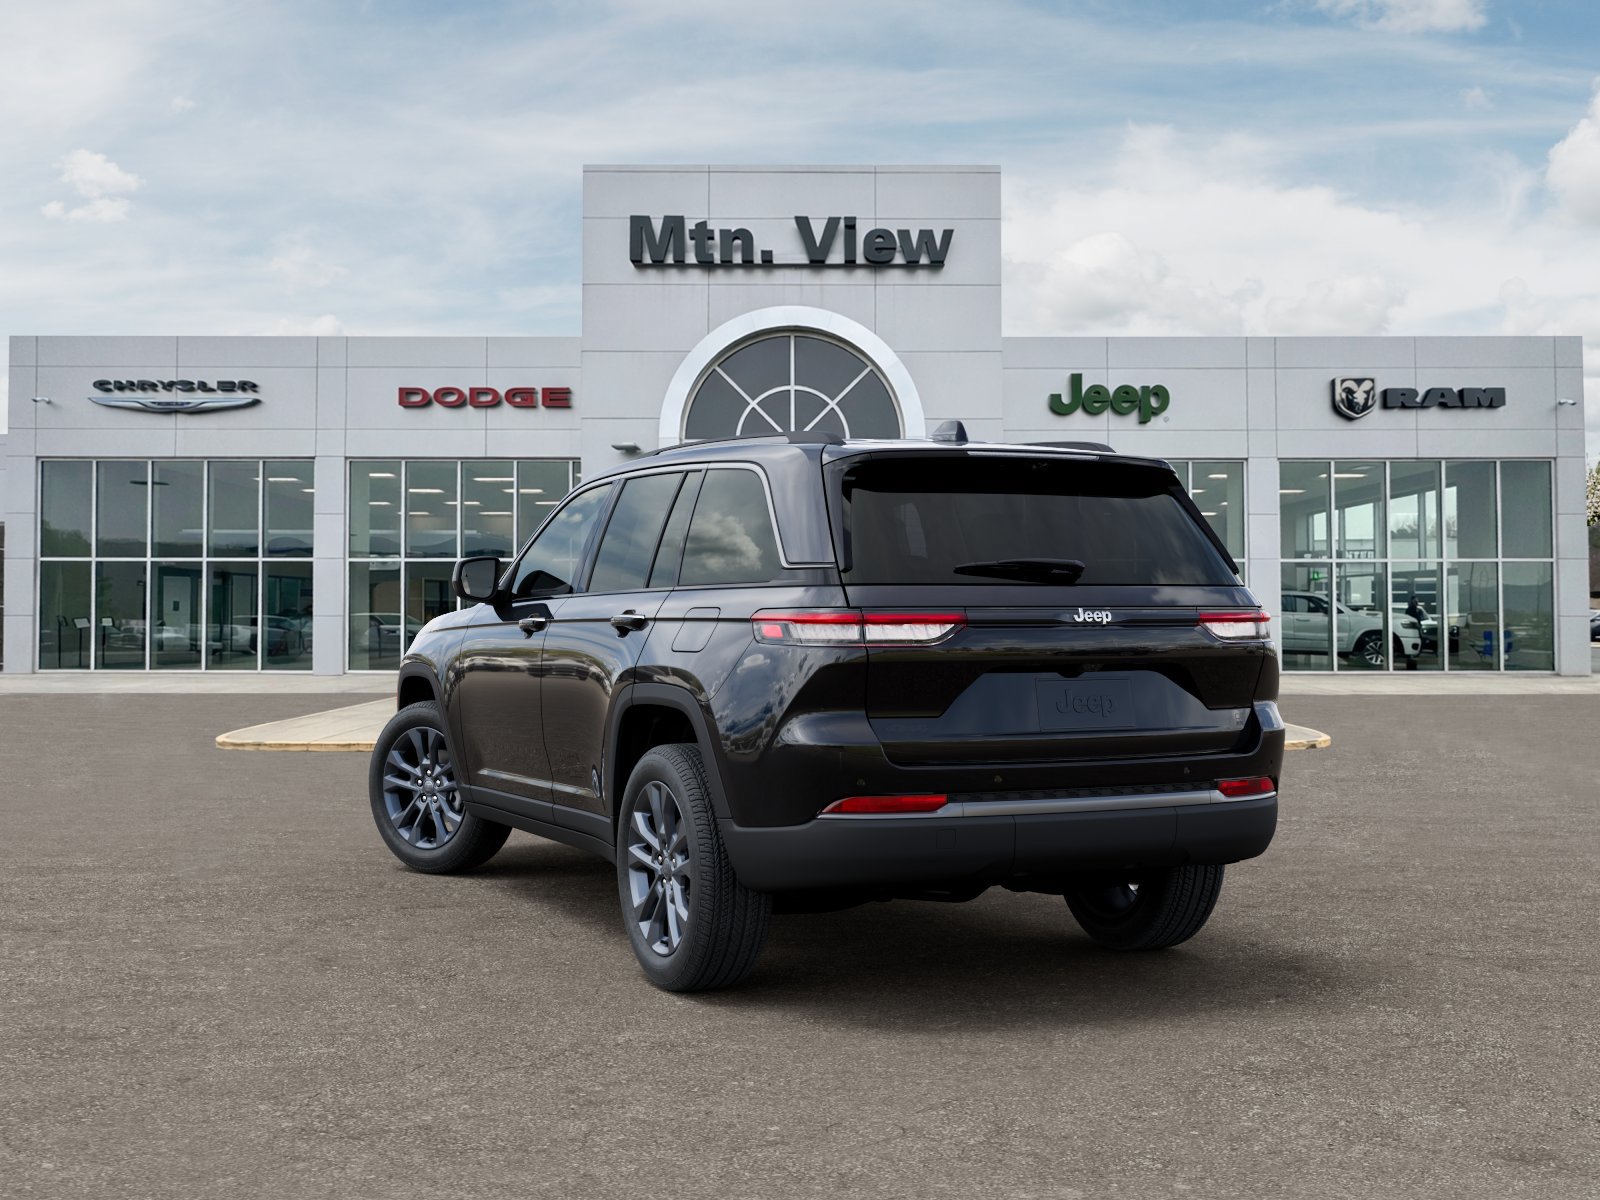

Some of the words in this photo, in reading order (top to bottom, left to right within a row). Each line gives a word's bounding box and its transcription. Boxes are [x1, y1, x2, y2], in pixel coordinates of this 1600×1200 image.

[630, 214, 773, 265] Mtn.
[794, 215, 954, 266] View
[92, 379, 259, 393] CHRYSLER
[398, 387, 572, 408] DODGE
[1049, 372, 1170, 424] Jeep
[1380, 387, 1506, 409] RAM
[1073, 607, 1112, 625] Jeep
[1055, 688, 1113, 718] Jeep
